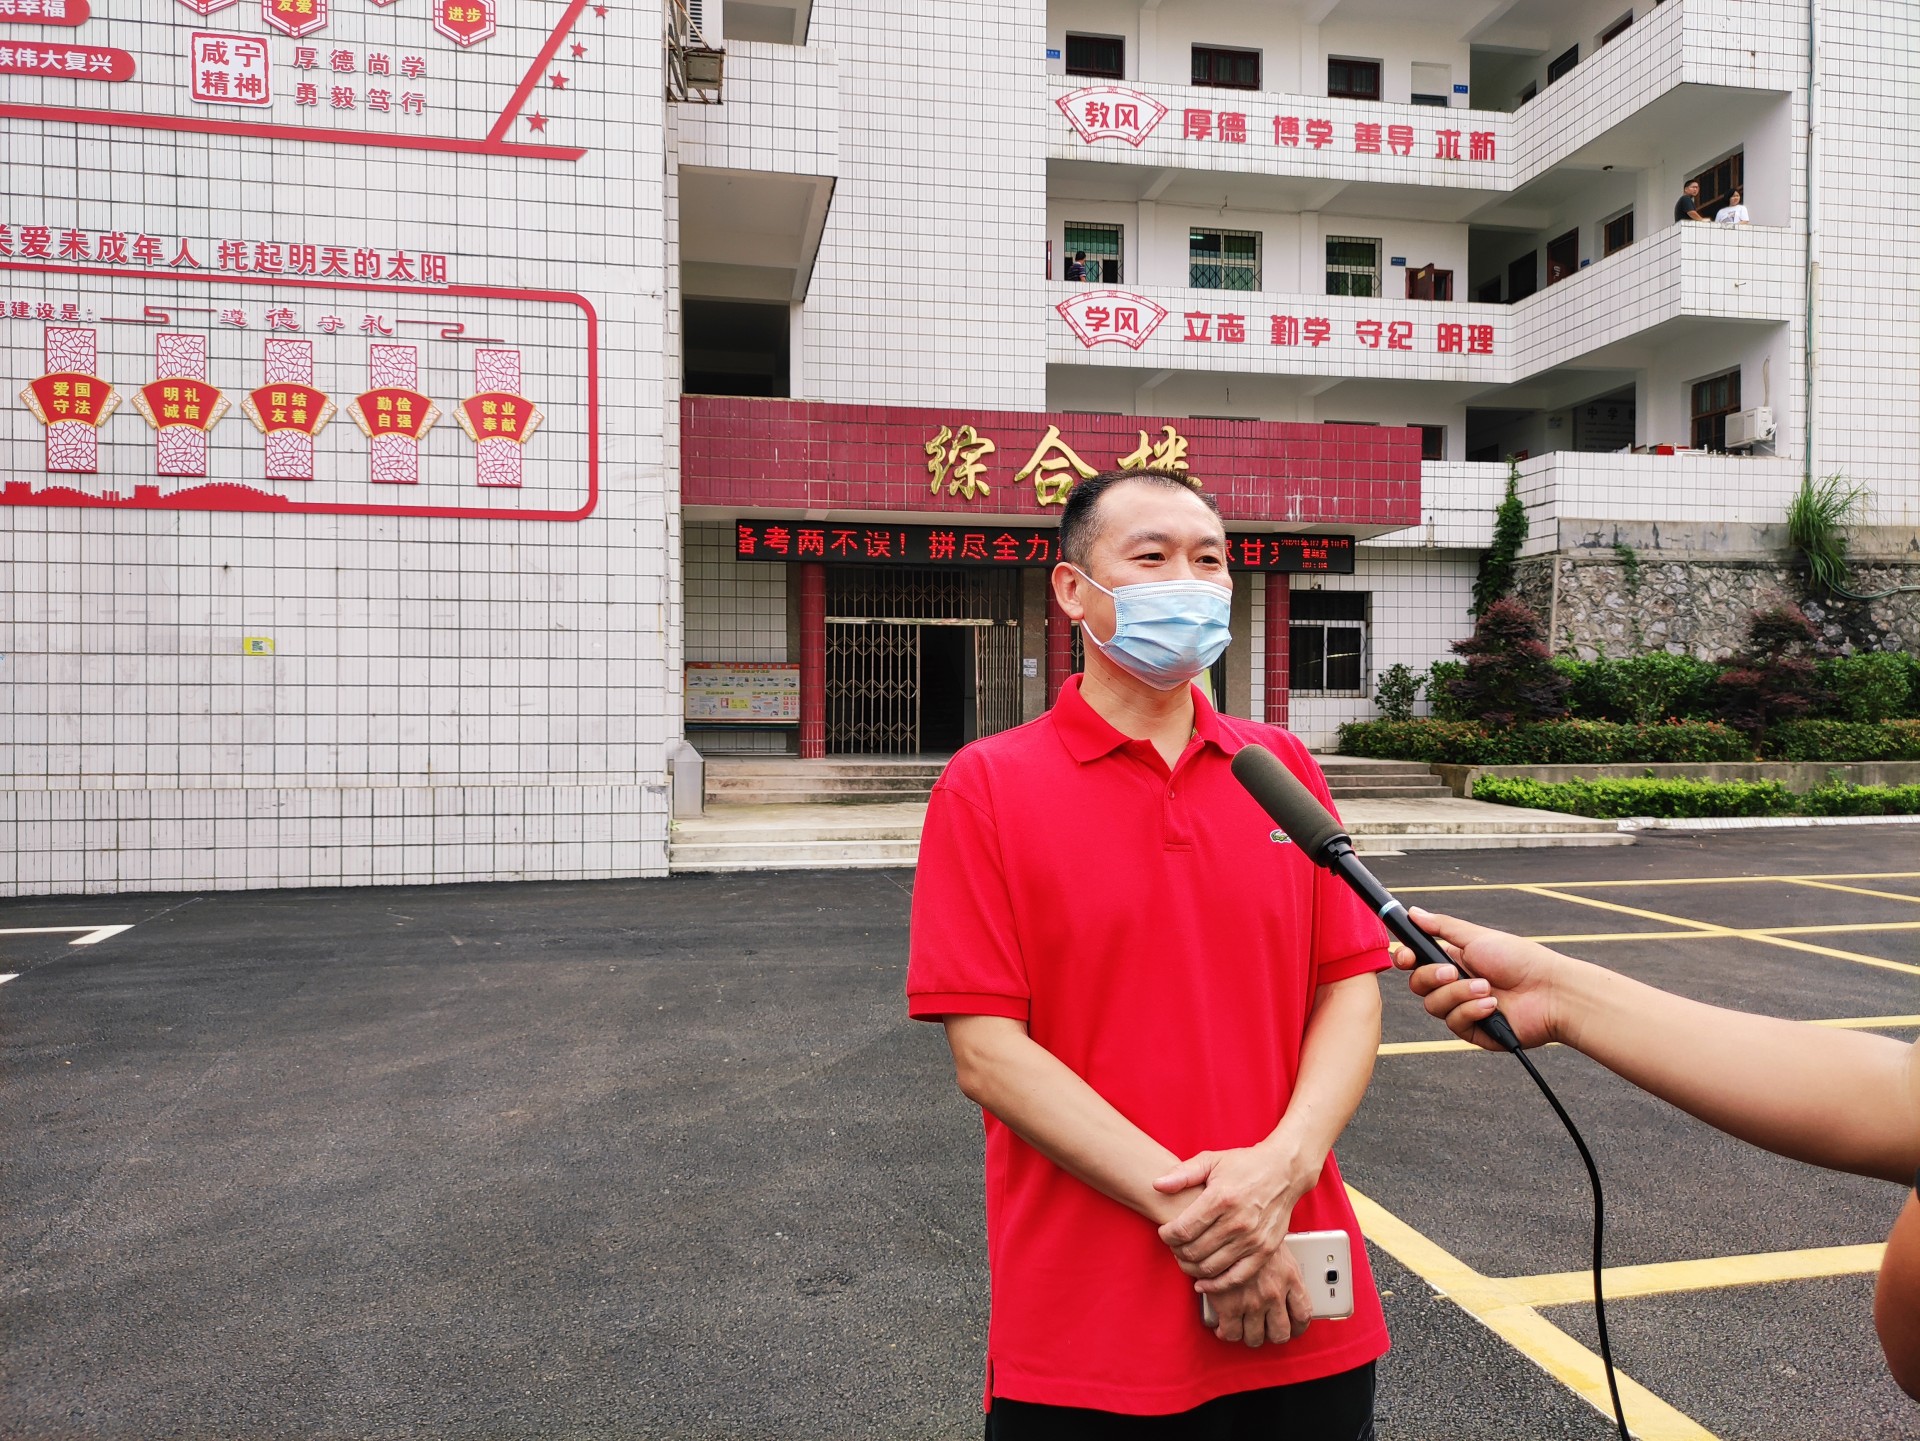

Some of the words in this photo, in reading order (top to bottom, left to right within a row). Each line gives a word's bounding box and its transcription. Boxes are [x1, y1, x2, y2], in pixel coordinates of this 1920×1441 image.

[448, 7, 482, 23] 进步
[201, 41, 261, 67] 咸宁
[293, 46, 427, 79] 厚德尚学
[201, 70, 262, 98] 精神
[296, 82, 427, 115] 勇毅笃行
[1085, 101, 1140, 131] 教风
[1184, 108, 1246, 143] 厚德
[1273, 115, 1334, 149] 博学
[1354, 122, 1414, 155] 善导
[1435, 129, 1496, 161] 求新
[218, 240, 448, 283] 托起明天的太阳
[1085, 306, 1140, 334] 学风
[1184, 311, 1245, 343] 立志
[1270, 314, 1331, 347] 勤学
[1356, 319, 1413, 350] 守纪
[1437, 323, 1494, 354] 明理
[53, 381, 91, 398] 爱国
[164, 387, 200, 402] 明礼
[53, 399, 91, 415] 守法
[271, 391, 308, 407] 团结
[376, 396, 413, 411] 勤俭
[164, 404, 200, 419] 诚信
[481, 400, 516, 416] 敬业
[271, 409, 308, 424] 友善
[377, 412, 413, 428] 自强
[482, 417, 516, 432] 奉献
